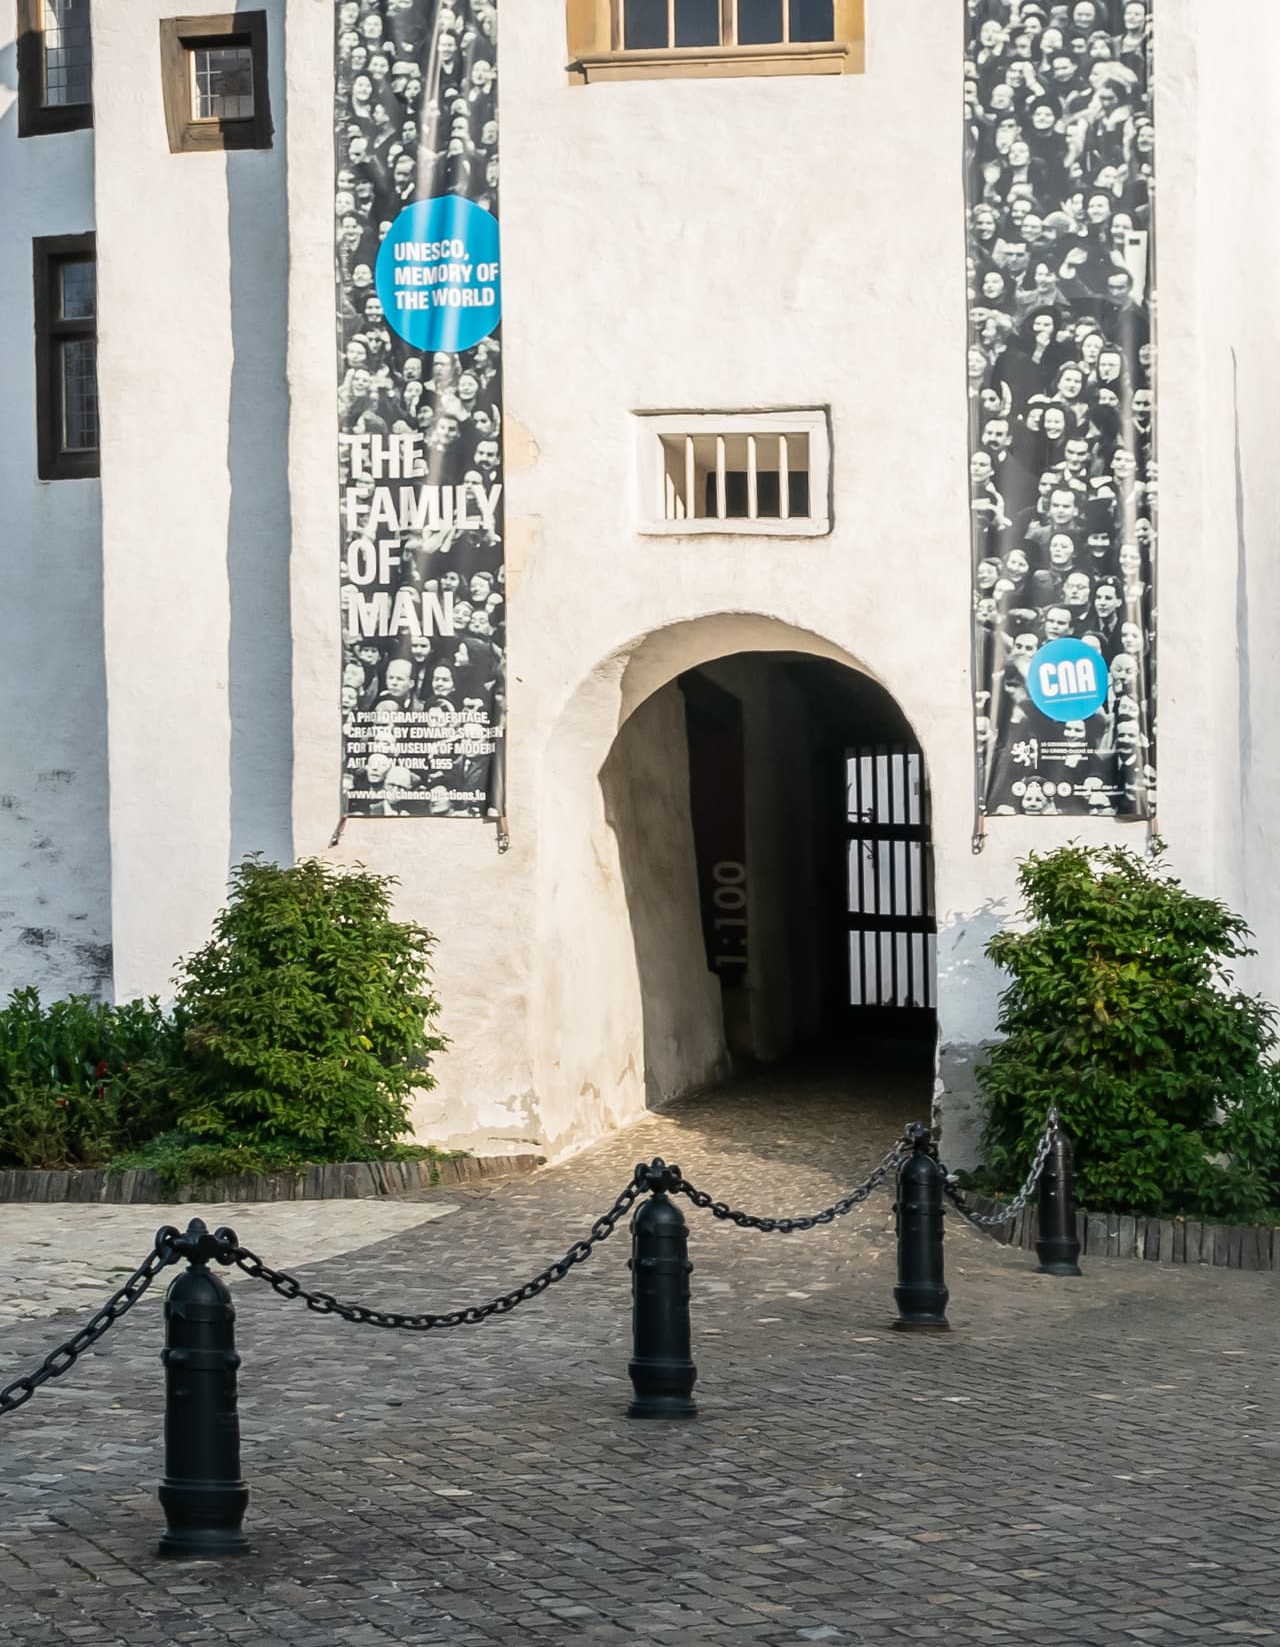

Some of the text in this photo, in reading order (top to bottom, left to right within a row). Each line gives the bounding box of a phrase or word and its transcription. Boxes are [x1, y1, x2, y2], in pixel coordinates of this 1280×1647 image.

[394, 240, 470, 261] UNESCO,
[394, 263, 499, 285] MEMORY OF
[394, 287, 495, 310] THE WORLD
[338, 432, 425, 479] THE
[345, 484, 503, 532] FAMILY
[348, 539, 402, 585] OF
[348, 591, 455, 637] MAN
[346, 711, 356, 723] A
[357, 711, 438, 723] PHOTOGRAPHIC
[394, 726, 409, 739] BY
[410, 727, 456, 739] EDWARD
[347, 742, 367, 754] FOR
[368, 742, 389, 754] THE
[391, 742, 438, 755] MUSEUM
[439, 742, 453, 754] OF
[370, 757, 396, 769] EW
[430, 758, 453, 770] 1955
[712, 860, 748, 968] 1:100
